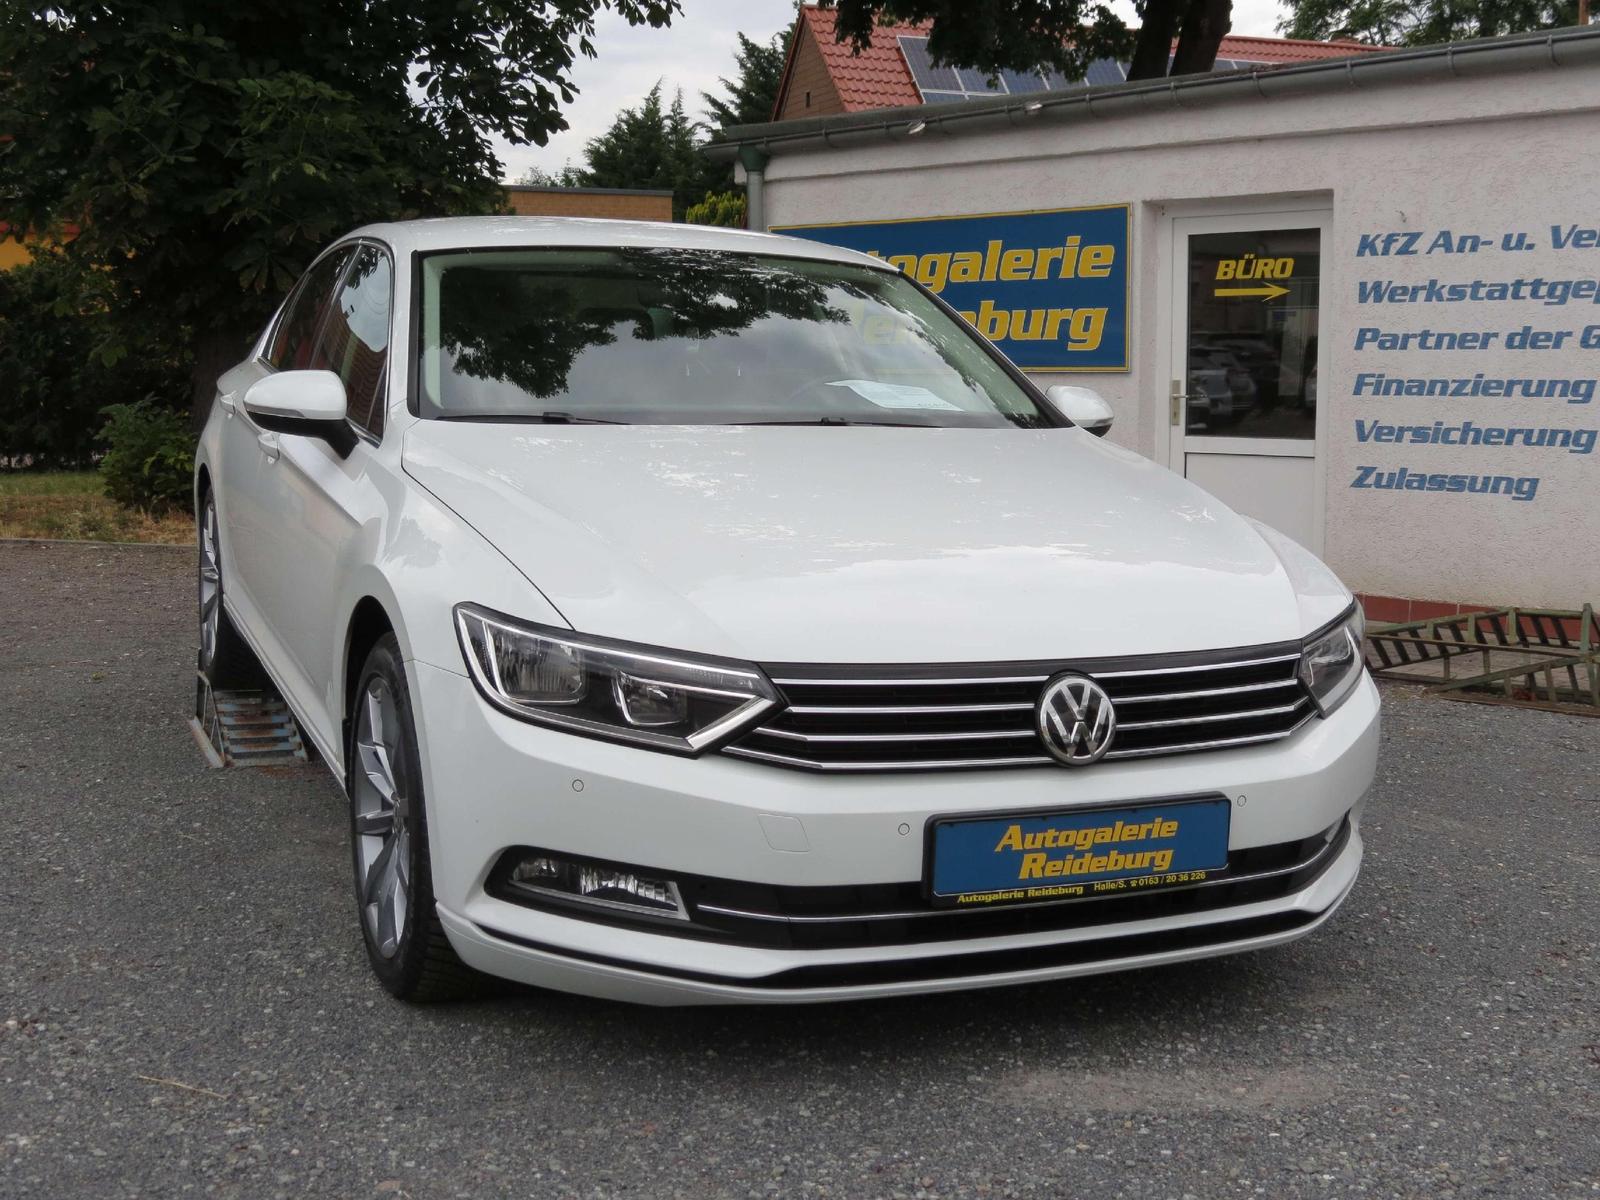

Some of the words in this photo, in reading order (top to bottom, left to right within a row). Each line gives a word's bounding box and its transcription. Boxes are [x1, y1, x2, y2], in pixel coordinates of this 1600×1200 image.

[1501, 232, 1536, 251] u.
[1550, 224, 1600, 249] Ve
[866, 236, 1116, 294] ogalerie
[1215, 254, 1295, 280] BÜRO
[1354, 327, 1499, 350] Partner
[1505, 325, 1573, 350] der
[1352, 373, 1597, 404] Finanzierung
[1354, 419, 1598, 454] Versicherung
[1350, 465, 1540, 501] Zulassung
[994, 816, 1179, 853] Autogalerie
[1018, 849, 1175, 880] Reideburg
[957, 888, 1025, 904] Autogalerie
[1027, 884, 1084, 898] Reideburg
